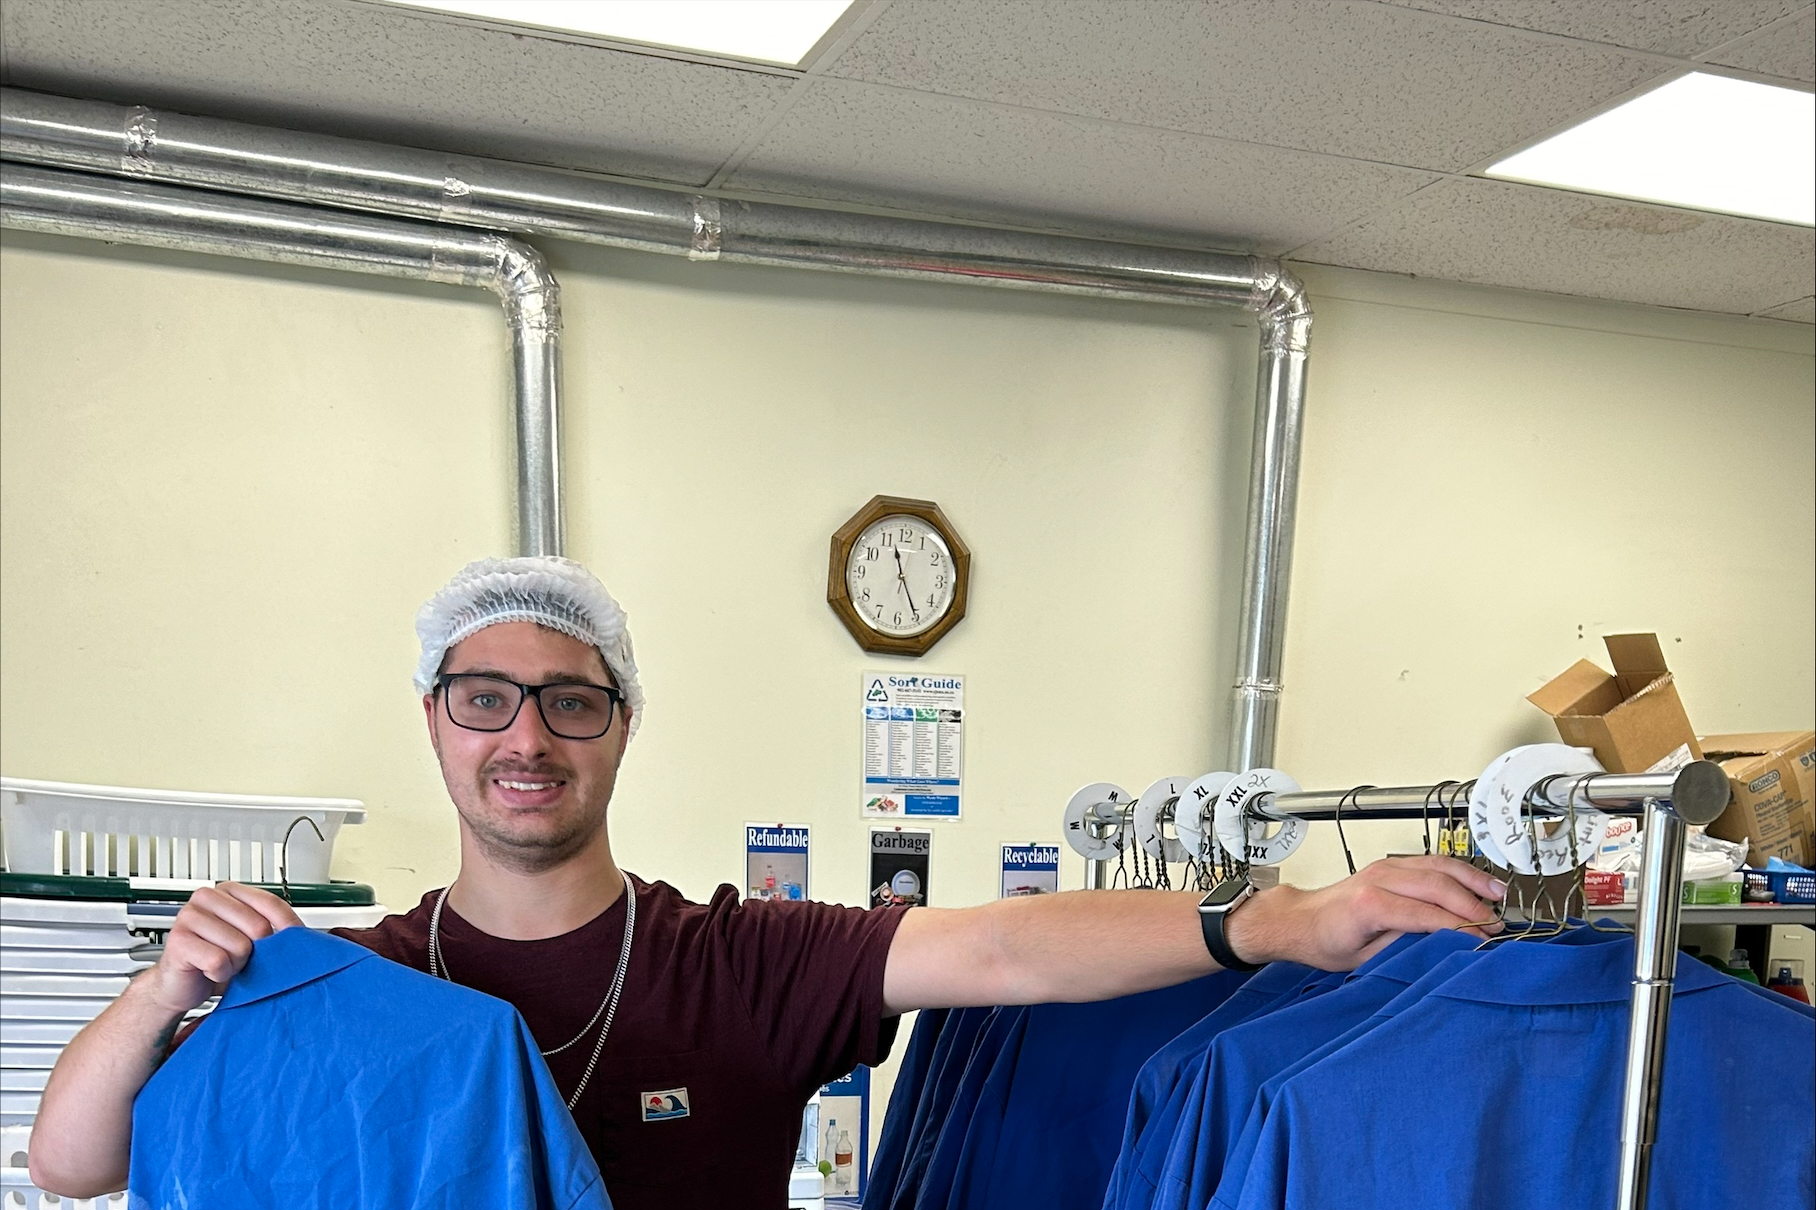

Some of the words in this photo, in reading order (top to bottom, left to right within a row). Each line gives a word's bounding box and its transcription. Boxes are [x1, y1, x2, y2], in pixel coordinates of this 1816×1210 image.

[881, 532, 892, 547] 11
[898, 528, 913, 543] 12
[919, 536, 925, 550] 1
[866, 547, 879, 562] 10
[930, 552, 939, 567] 2
[857, 565, 866, 579] 9
[935, 575, 944, 589] 3
[861, 588, 870, 602] 8
[926, 593, 935, 608] 4
[875, 604, 883, 618] 7
[893, 611, 902, 626] 6
[911, 608, 920, 623] 5
[889, 676, 918, 688] Sort
[921, 678, 962, 690] Guide
[1247, 773, 1271, 788] 2X
[1752, 772, 1779, 791] RONCO
[1170, 783, 1176, 794] L
[1193, 785, 1209, 800] XL
[1225, 785, 1248, 807] XXL
[1606, 821, 1632, 839] bounce
[748, 828, 809, 848] Refundable
[871, 833, 929, 853] Garbage
[1003, 847, 1058, 868] Recyclable
[1777, 843, 1794, 860] 771
[1732, 883, 1738, 896] S
